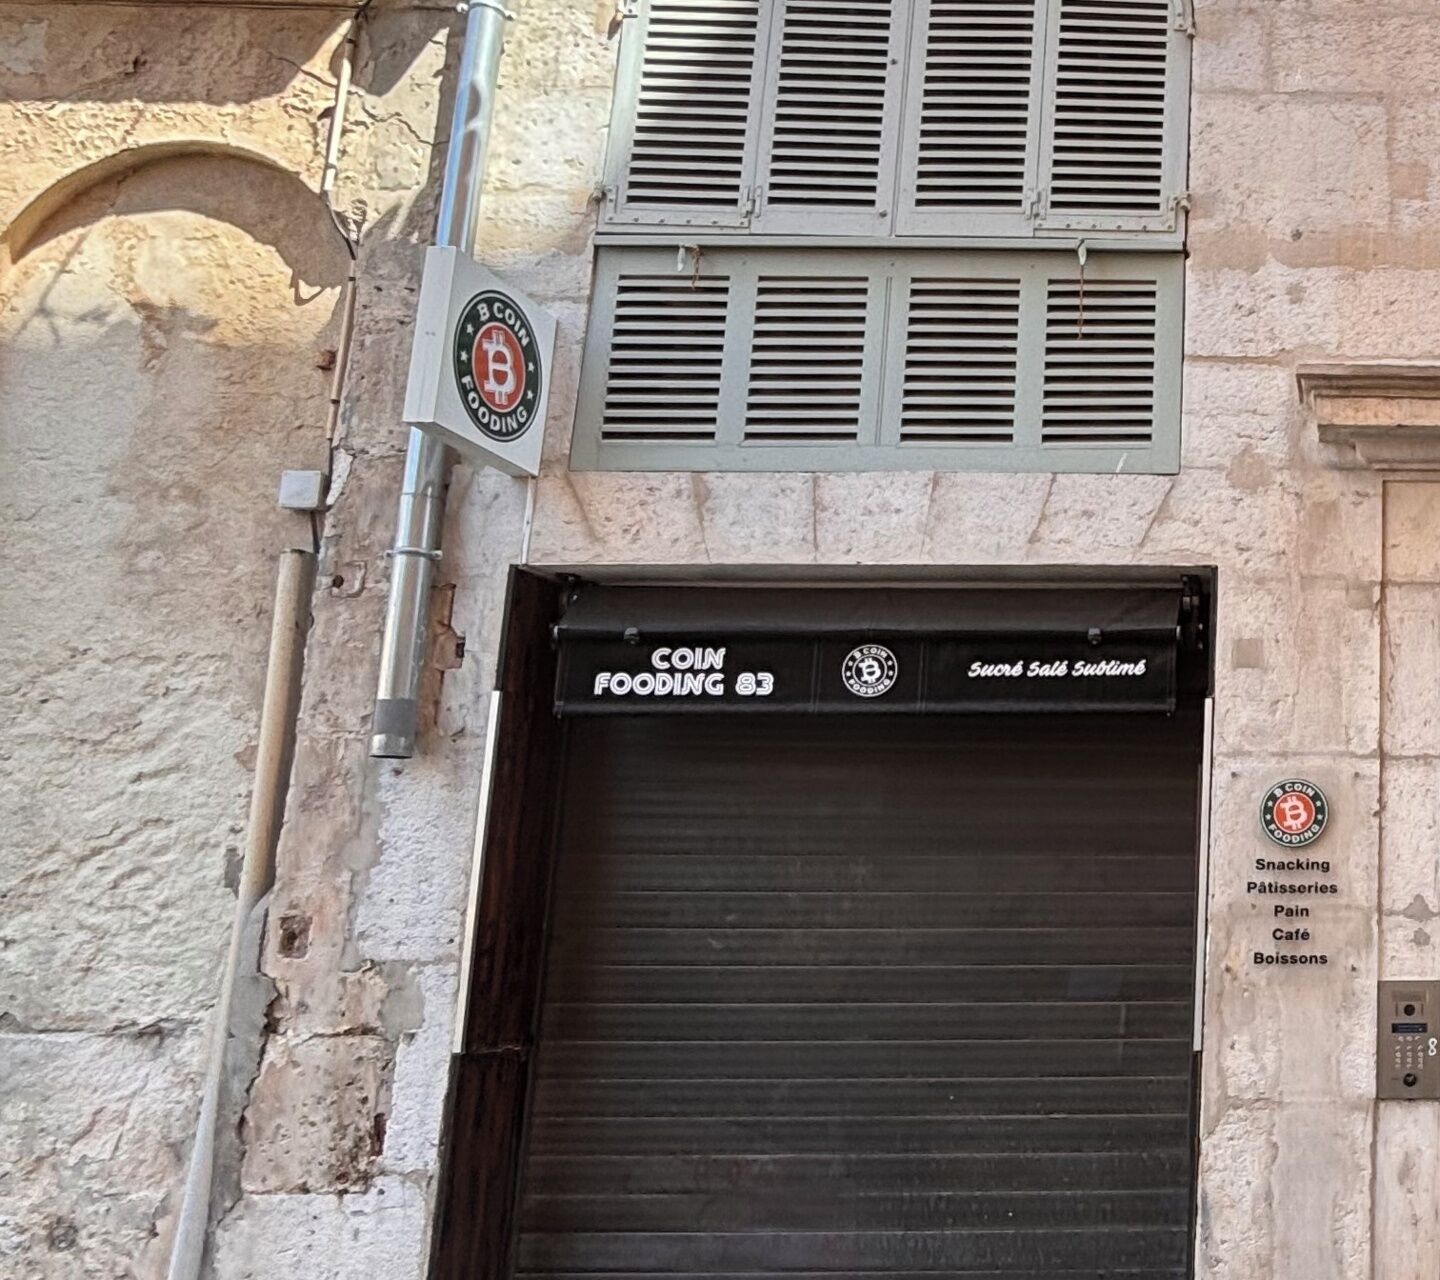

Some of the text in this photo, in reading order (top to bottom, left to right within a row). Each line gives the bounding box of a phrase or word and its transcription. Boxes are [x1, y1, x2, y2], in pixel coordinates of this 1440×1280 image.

[493, 302, 530, 347] COIN
[461, 374, 528, 433] FOODING
[651, 647, 726, 670] COIN
[862, 647, 888, 658] COIN
[967, 659, 1147, 677] Sucré Salé Sublimé
[594, 672, 774, 696] FOODING 83
[848, 678, 891, 694] FOODING
[1285, 783, 1316, 798] COIN
[1268, 824, 1320, 843] FOODING
[1255, 858, 1330, 873] Snacking
[1247, 881, 1338, 894] Pâtisseries
[1274, 905, 1309, 917] Pain
[1272, 928, 1310, 941] Café
[1253, 952, 1328, 965] Boissons
